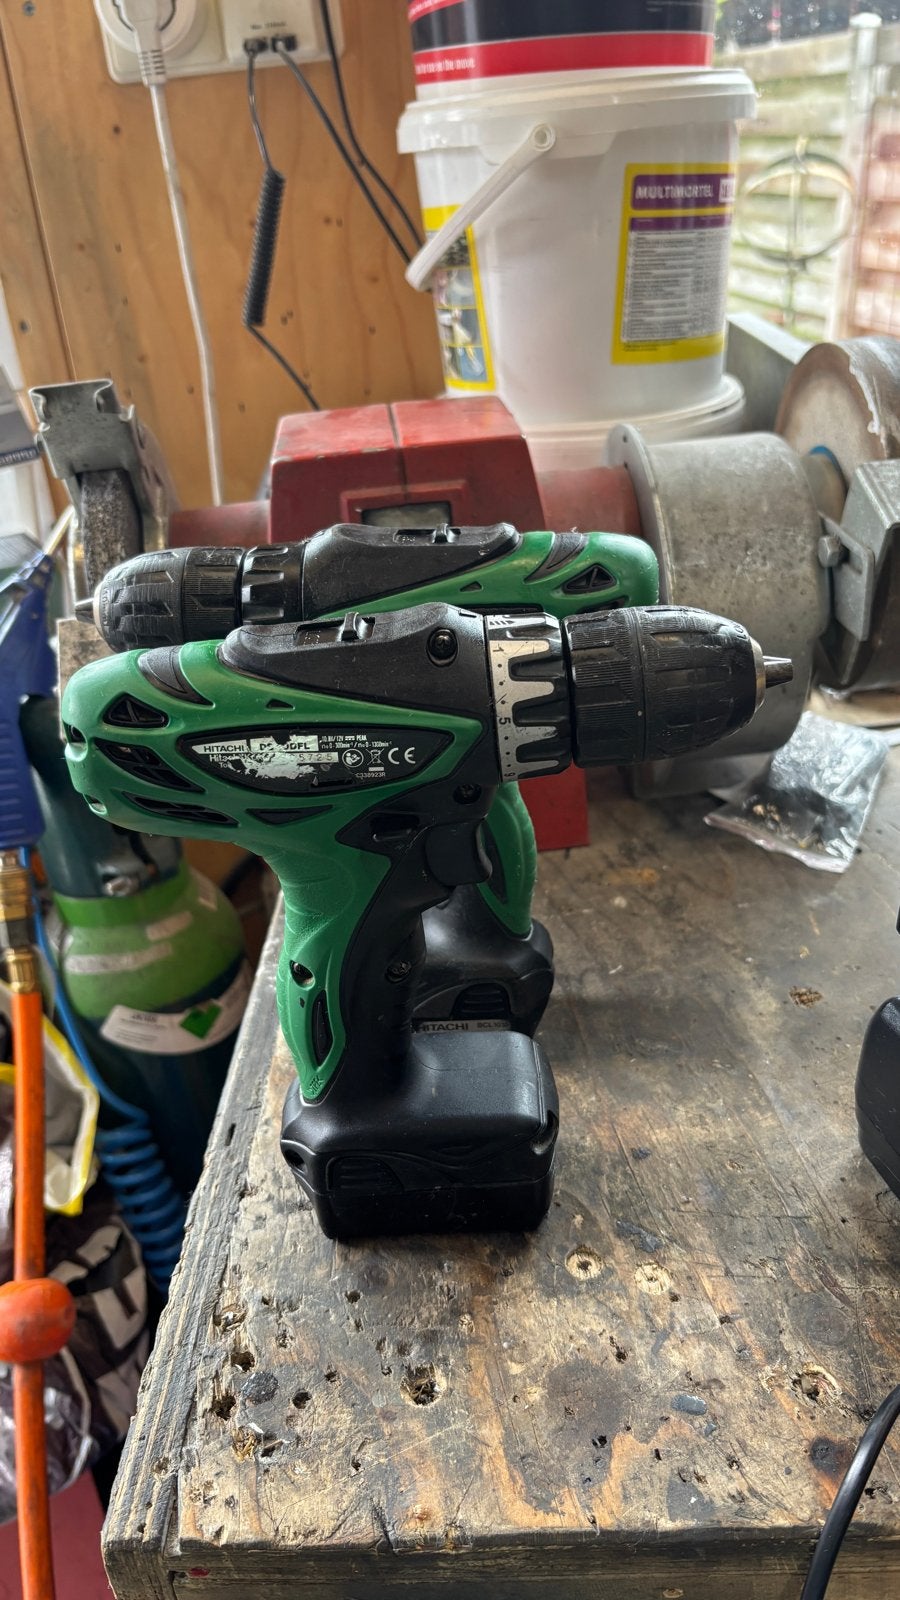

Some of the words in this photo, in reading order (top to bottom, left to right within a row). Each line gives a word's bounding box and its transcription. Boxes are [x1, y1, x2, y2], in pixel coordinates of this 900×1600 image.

[499, 717, 511, 725] 5
[203, 744, 245, 753] HITACHI
[419, 1021, 469, 1032] HITACHI
